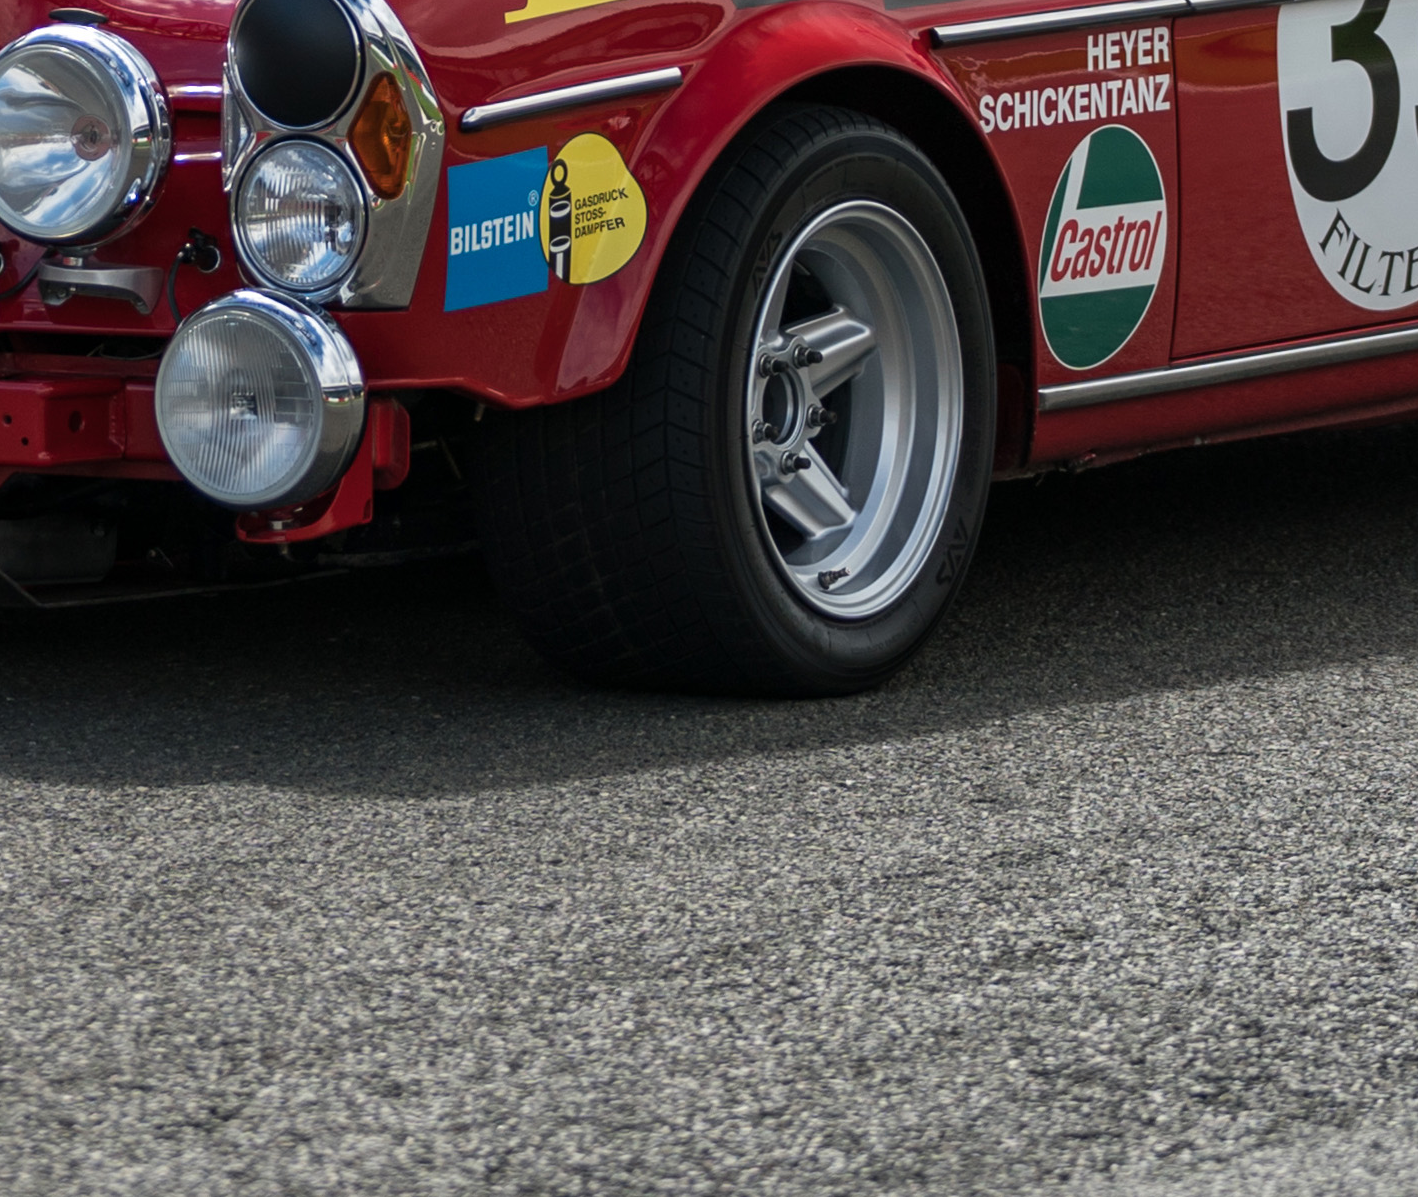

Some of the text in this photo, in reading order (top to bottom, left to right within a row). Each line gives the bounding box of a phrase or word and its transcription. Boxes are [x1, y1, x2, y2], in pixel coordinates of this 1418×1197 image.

[1086, 26, 1170, 72] HEYER
[979, 75, 1171, 134] SCHICKENTANZ
[574, 187, 629, 211] GASDRUCK
[574, 207, 607, 225] STOSS-
[450, 210, 534, 256] BILSTEIN
[1049, 210, 1163, 282] Castrol
